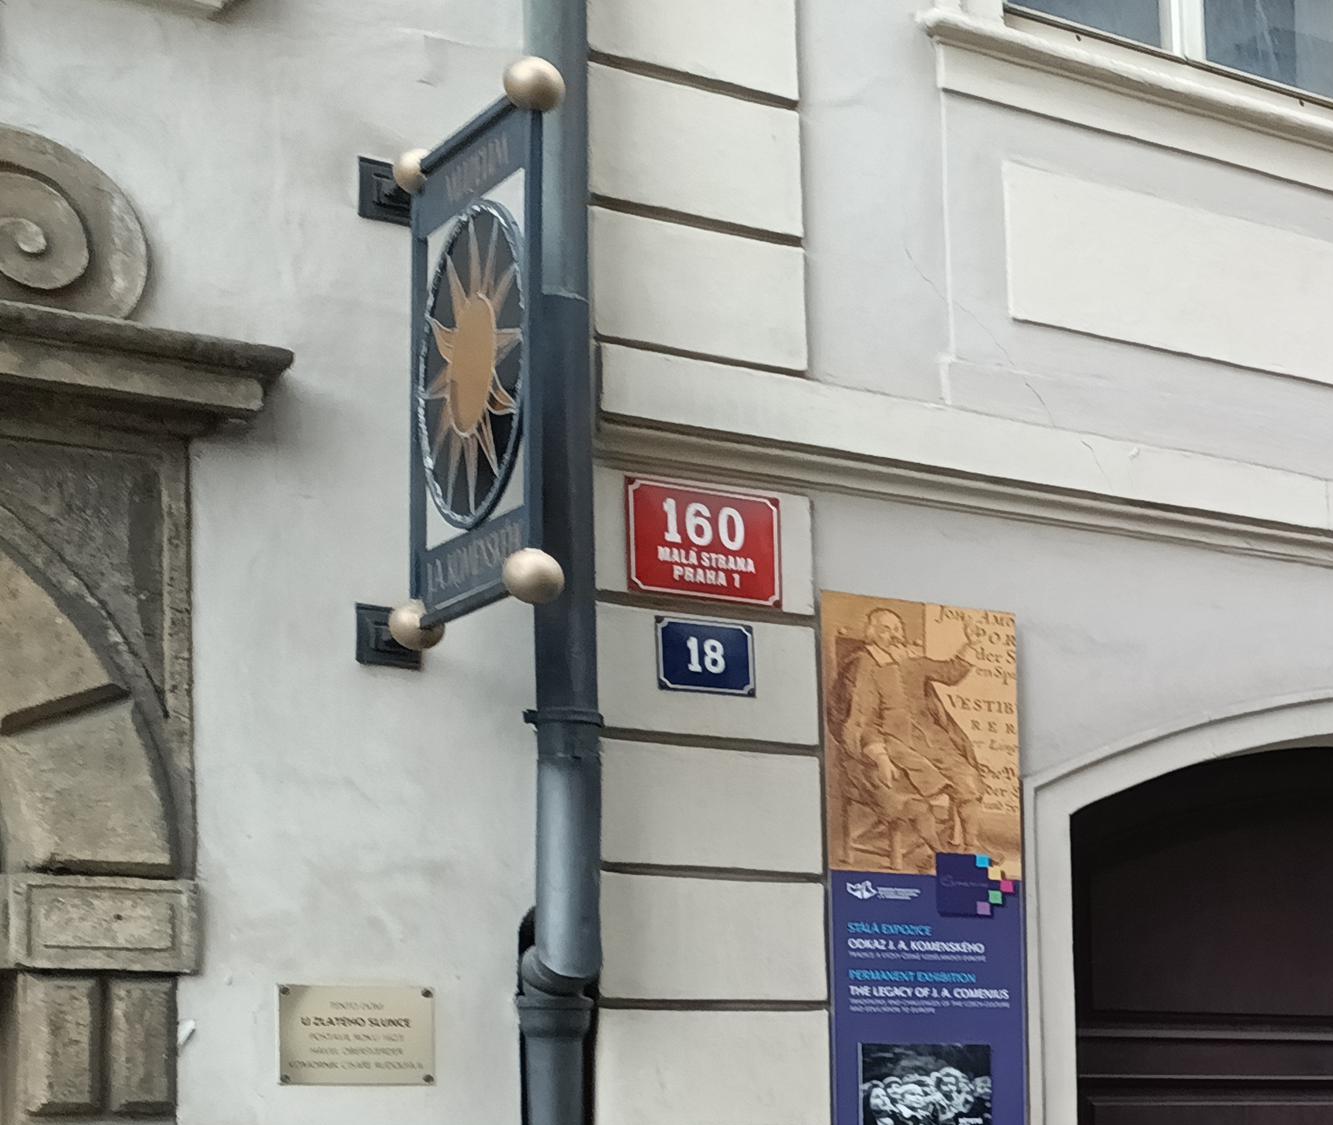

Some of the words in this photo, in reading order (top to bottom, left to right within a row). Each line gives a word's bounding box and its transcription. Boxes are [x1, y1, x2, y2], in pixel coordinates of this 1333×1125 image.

[662, 497, 745, 551] 160
[657, 545, 698, 565] MALÁ
[701, 553, 756, 574] STRANA
[672, 565, 727, 587] PRAHA
[734, 574, 741, 589] 1
[686, 636, 726, 674] 18
[847, 938, 887, 950] ODKAZ
[848, 969, 915, 982] PERMANENT
[849, 985, 871, 997] THE
[872, 986, 913, 997] LEGACY
[914, 987, 930, 998] OF
[953, 988, 1010, 1000] COMENIUS
